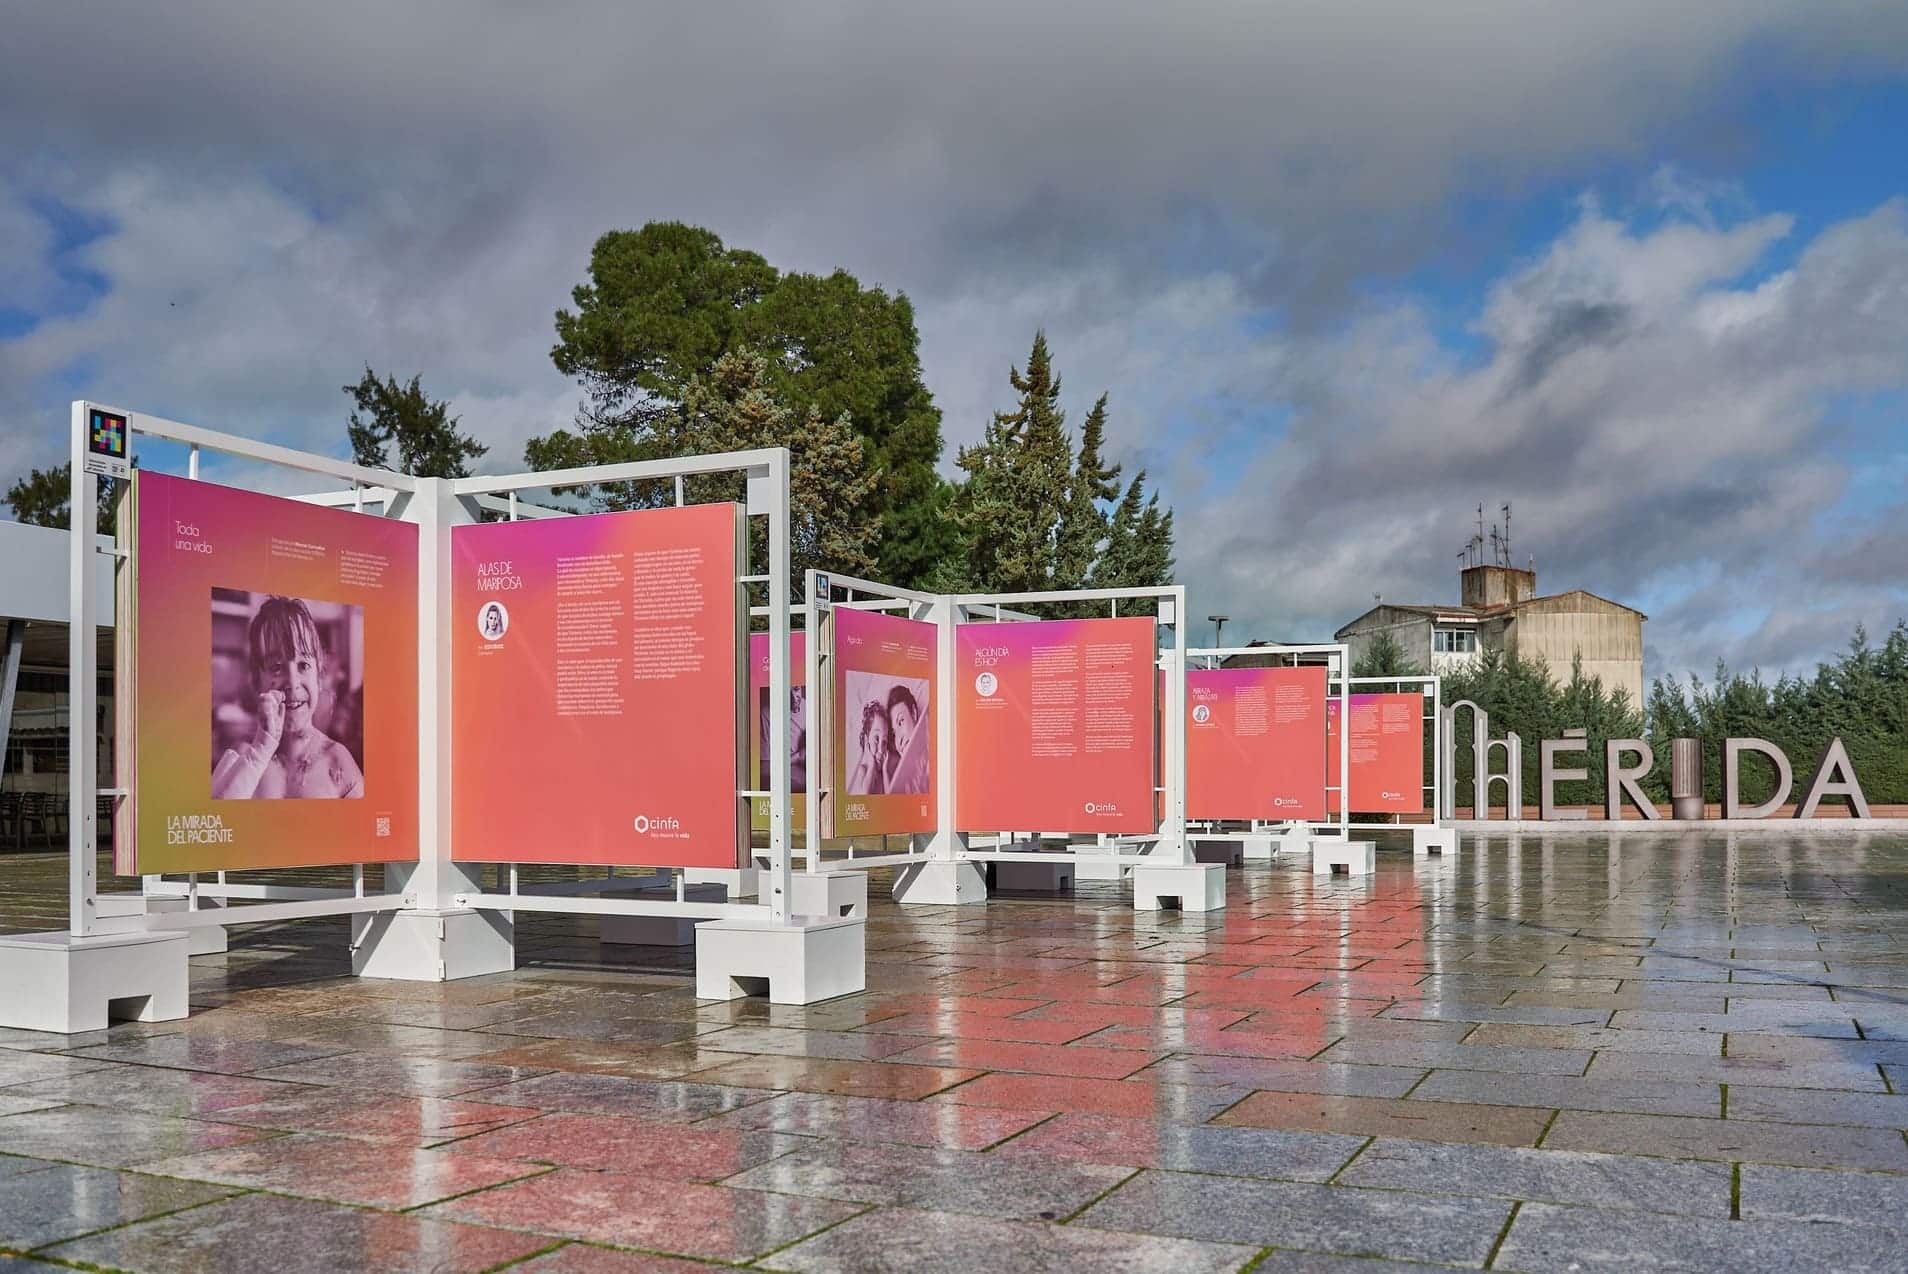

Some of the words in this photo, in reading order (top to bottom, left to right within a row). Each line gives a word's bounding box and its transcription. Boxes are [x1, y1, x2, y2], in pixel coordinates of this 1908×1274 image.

[175, 520, 200, 537] Toda
[175, 538, 192, 551] una
[192, 539, 213, 554] vida
[477, 561, 499, 576] ALAS
[500, 560, 513, 575] DE
[1440, 700, 1871, 821] MÉRIDA
[167, 815, 181, 830] LA
[182, 814, 223, 830] MIRADA
[167, 830, 187, 844] DEL
[187, 829, 233, 844] PACIENTE
